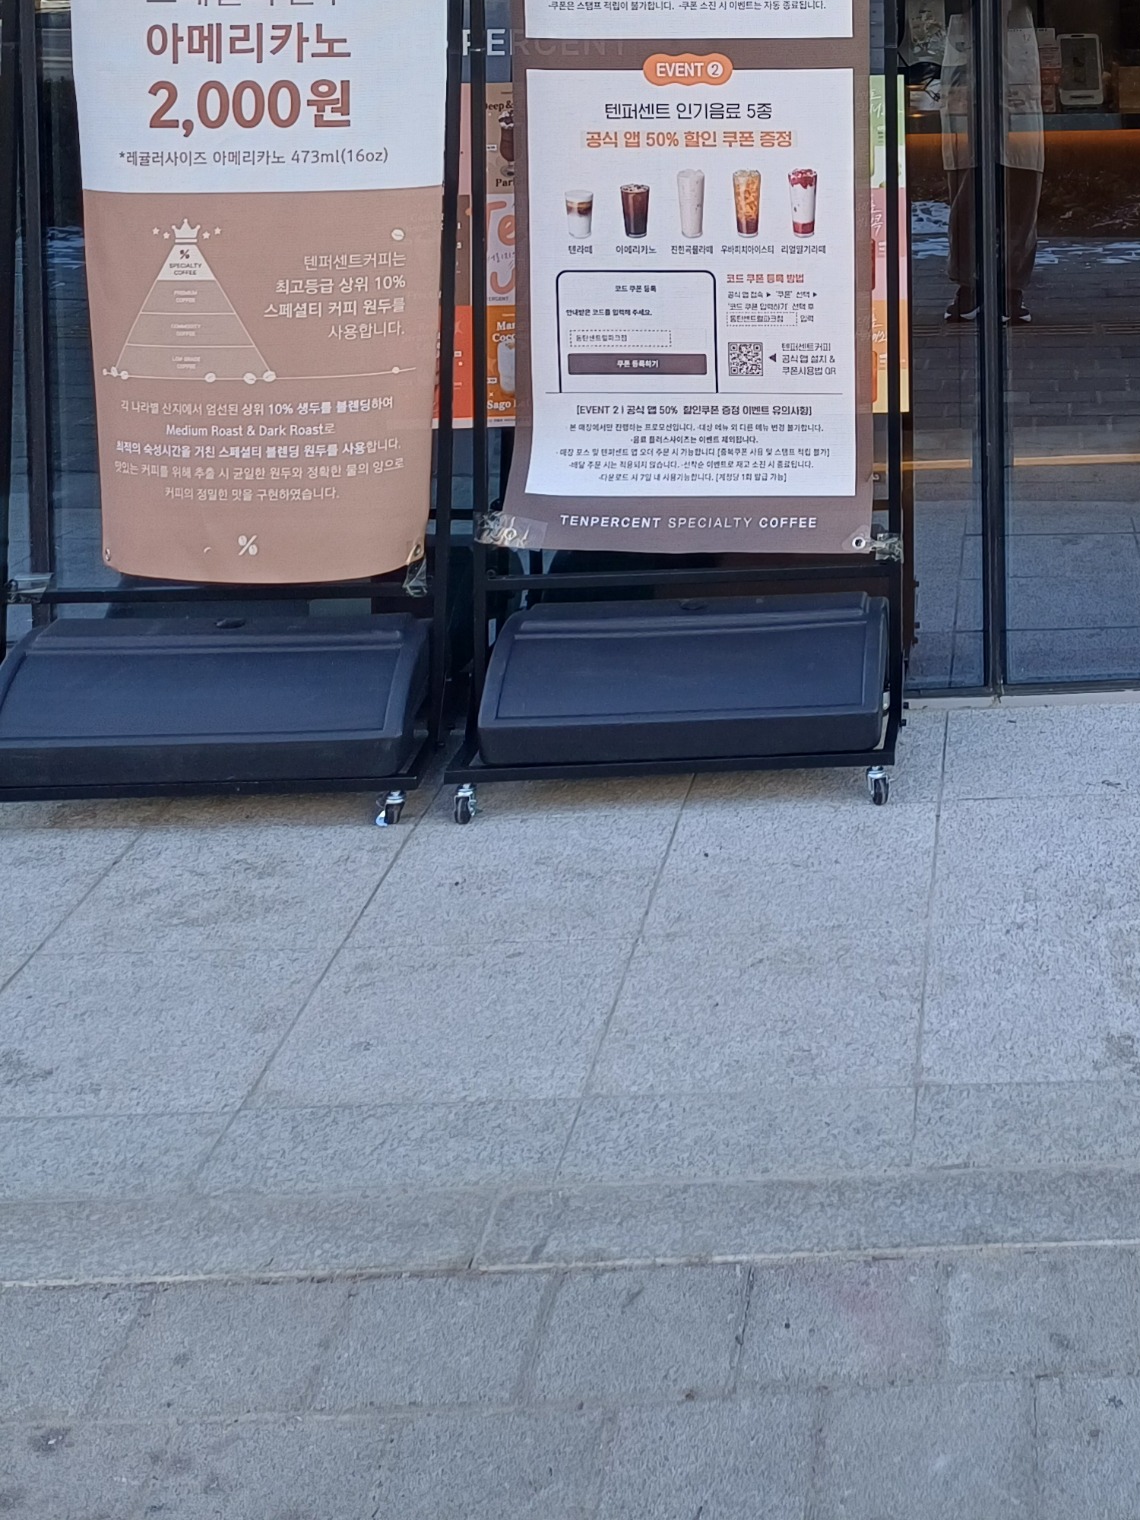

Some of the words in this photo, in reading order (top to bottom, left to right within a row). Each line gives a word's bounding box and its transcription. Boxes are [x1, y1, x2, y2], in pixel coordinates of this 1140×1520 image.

[147, 22, 351, 64] 아메리카노
[656, 63, 704, 77] EVENT
[148, 80, 351, 137] 2,000원
[605, 103, 670, 119] 텐퍼센트
[676, 103, 740, 119] 인기음료
[747, 103, 772, 119] 5종
[586, 131, 618, 148] 공식
[624, 131, 641, 148] 앱
[646, 132, 679, 147] 50%
[684, 131, 717, 148] 할인
[722, 131, 754, 147] 쿠폰
[760, 131, 792, 147] 증정
[213, 149, 286, 165] 아메리카노
[291, 146, 389, 165] 473ml(16oz)
[304, 251, 406, 271] 텐퍼센트커피는
[275, 278, 334, 295] 최고등급
[338, 276, 369, 293] 상위
[375, 275, 406, 289] 10%
[264, 301, 322, 318] 스페셜티
[328, 300, 357, 316] 커피
[363, 297, 406, 314] 원두를
[328, 320, 405, 340] 사용합니다.
[132, 401, 159, 414] 나라별
[163, 401, 201, 416] 산지에서
[206, 403, 238, 416] 엄선된
[242, 403, 264, 416] 상위
[268, 403, 293, 415] 10%
[336, 396, 393, 413] 블렌딩하여
[577, 405, 610, 415] [EVENT
[660, 406, 678, 414] 50%
[722, 405, 739, 415] 증정
[743, 405, 769, 415] 이벤트
[166, 424, 207, 436] Medium
[211, 425, 243, 437] Roast
[247, 425, 255, 436] &
[259, 424, 286, 436] Dark
[290, 423, 335, 436] Roast로
[219, 445, 262, 459] 스페셜티
[266, 444, 299, 458] 블렌딩
[304, 443, 338, 456] 원두를
[342, 437, 401, 455] 사용합니다.
[219, 467, 229, 480] 시
[257, 486, 340, 501] 구현하였습니다.
[560, 515, 661, 528] TENPERCENT
[668, 517, 752, 529] SPECIALTY
[759, 517, 817, 528] COFFEE
